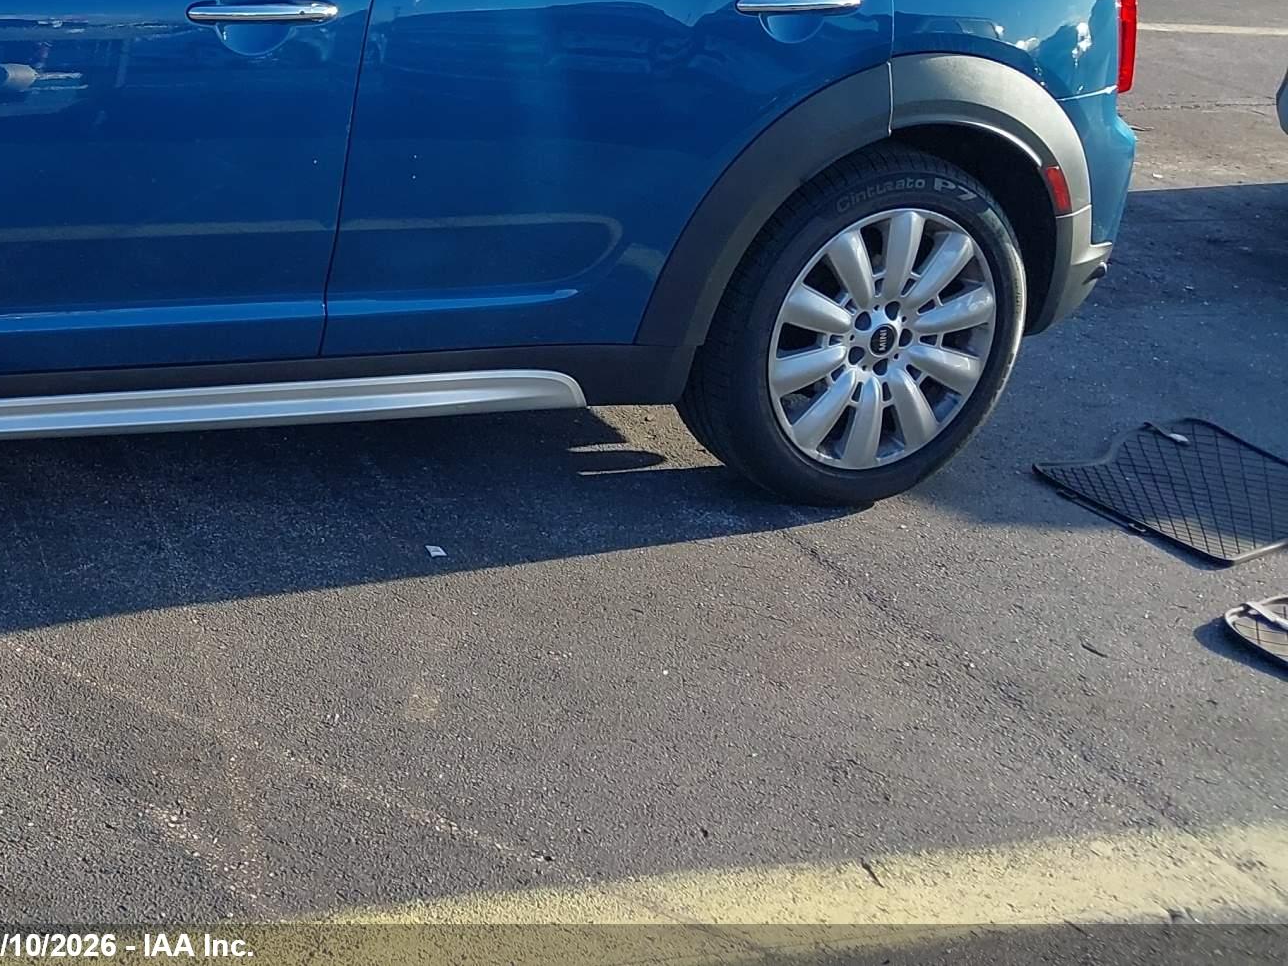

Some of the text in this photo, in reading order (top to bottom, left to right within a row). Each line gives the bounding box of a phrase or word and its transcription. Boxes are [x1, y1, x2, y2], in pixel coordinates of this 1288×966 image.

[834, 177, 977, 214] Cinturato P7
[878, 329, 888, 351] MINI
